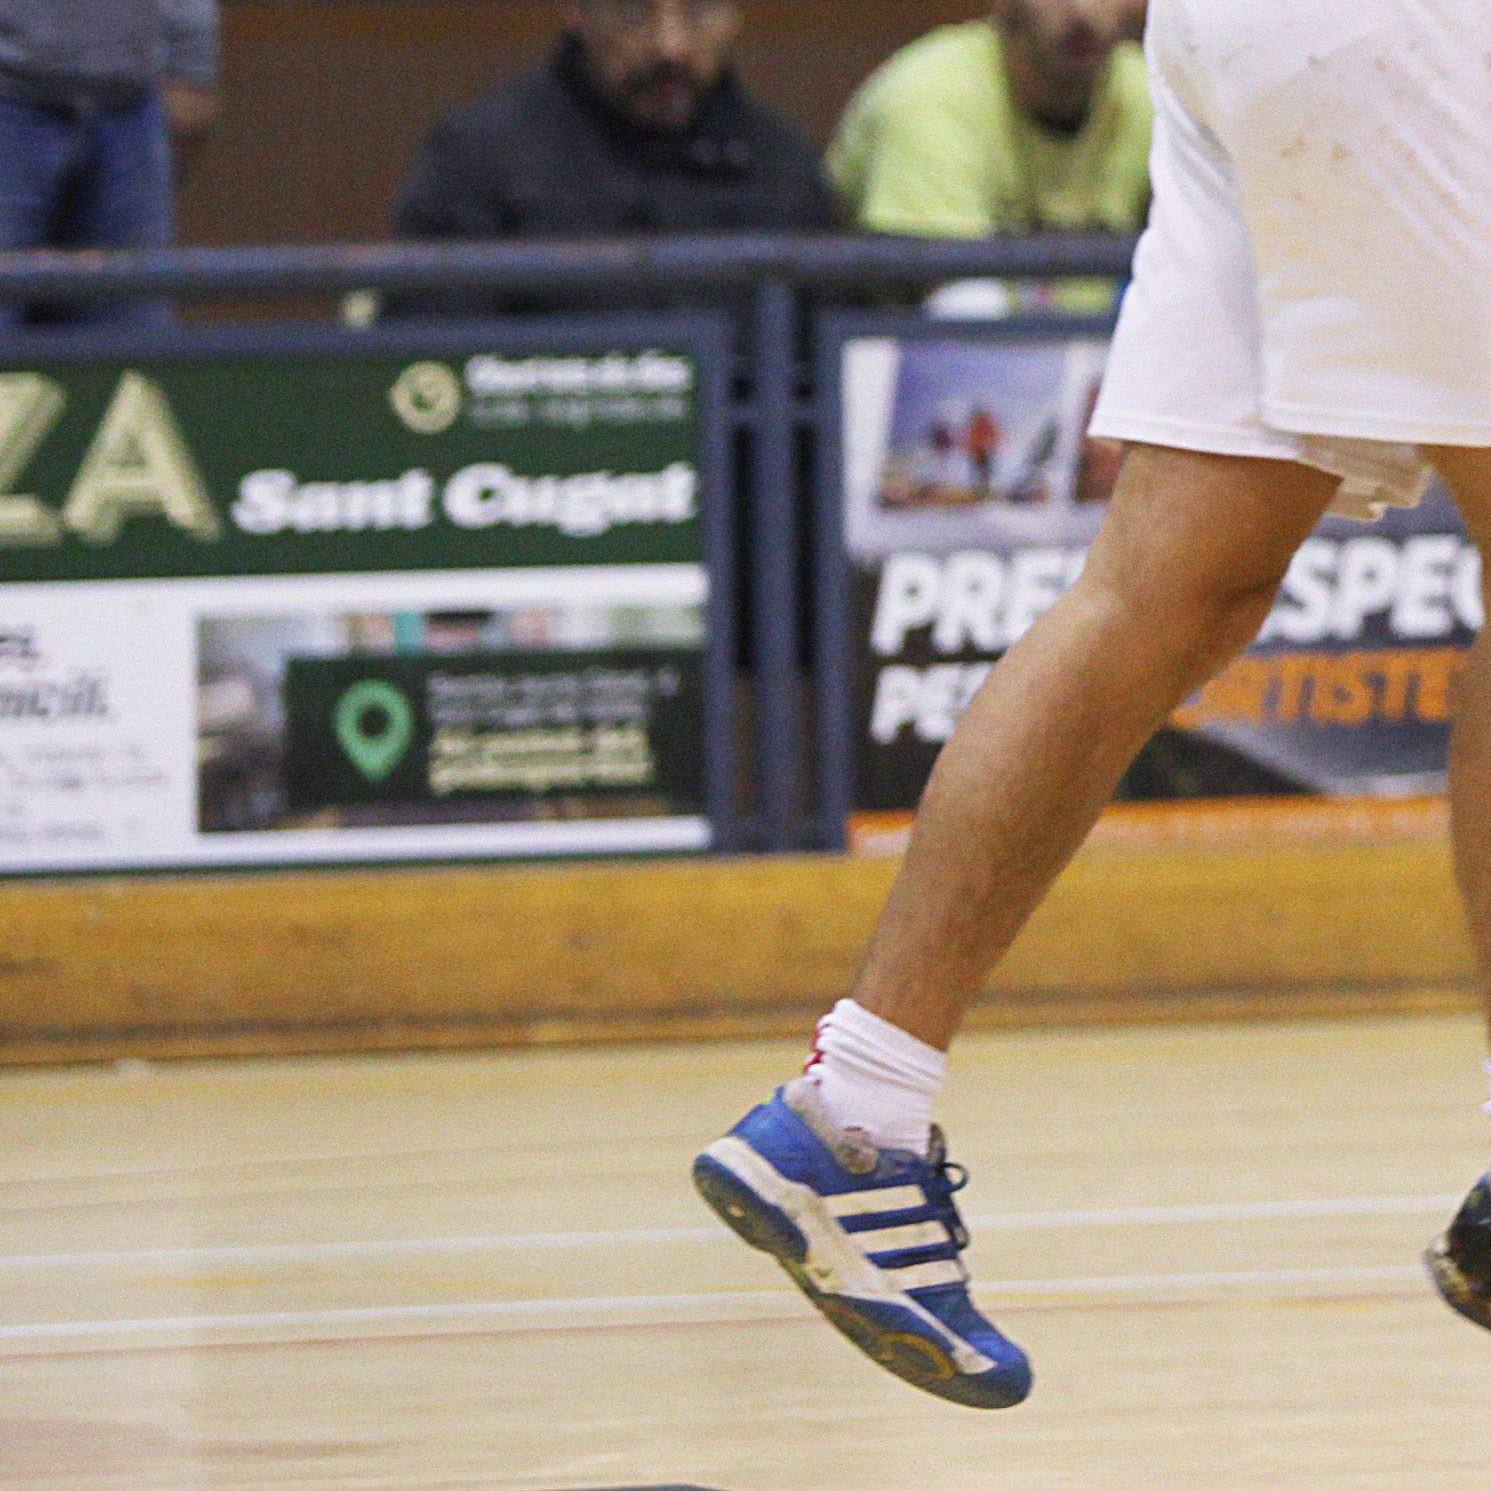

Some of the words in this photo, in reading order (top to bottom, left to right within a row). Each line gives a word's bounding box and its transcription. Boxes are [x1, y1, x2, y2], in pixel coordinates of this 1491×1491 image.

[230, 466, 436, 535] Sant
[445, 462, 698, 537] Cugat
[868, 546, 1094, 656] PRE
